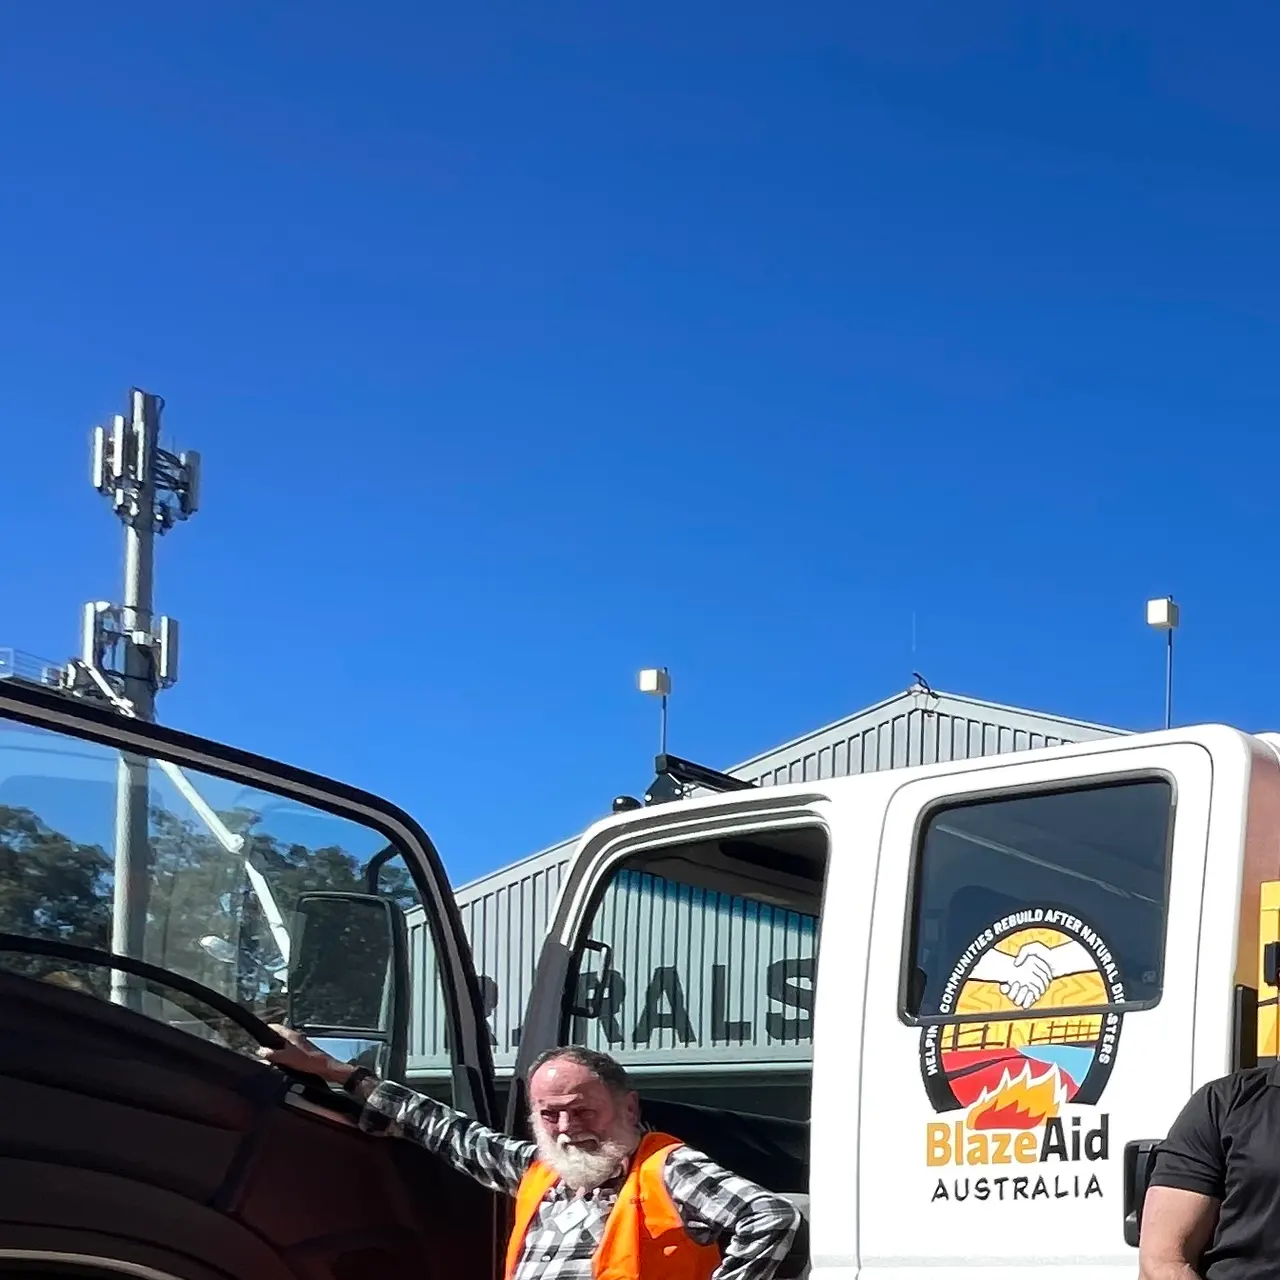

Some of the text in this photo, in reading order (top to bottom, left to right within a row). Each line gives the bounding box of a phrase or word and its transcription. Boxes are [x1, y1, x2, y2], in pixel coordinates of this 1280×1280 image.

[925, 908, 1125, 1076] HELPIN COMMUNITIES REBUILD AFTER NATURAL DISSTERS
[926, 1113, 1110, 1168] BlazeAid
[931, 1173, 1104, 1203] AUSTRALIA
